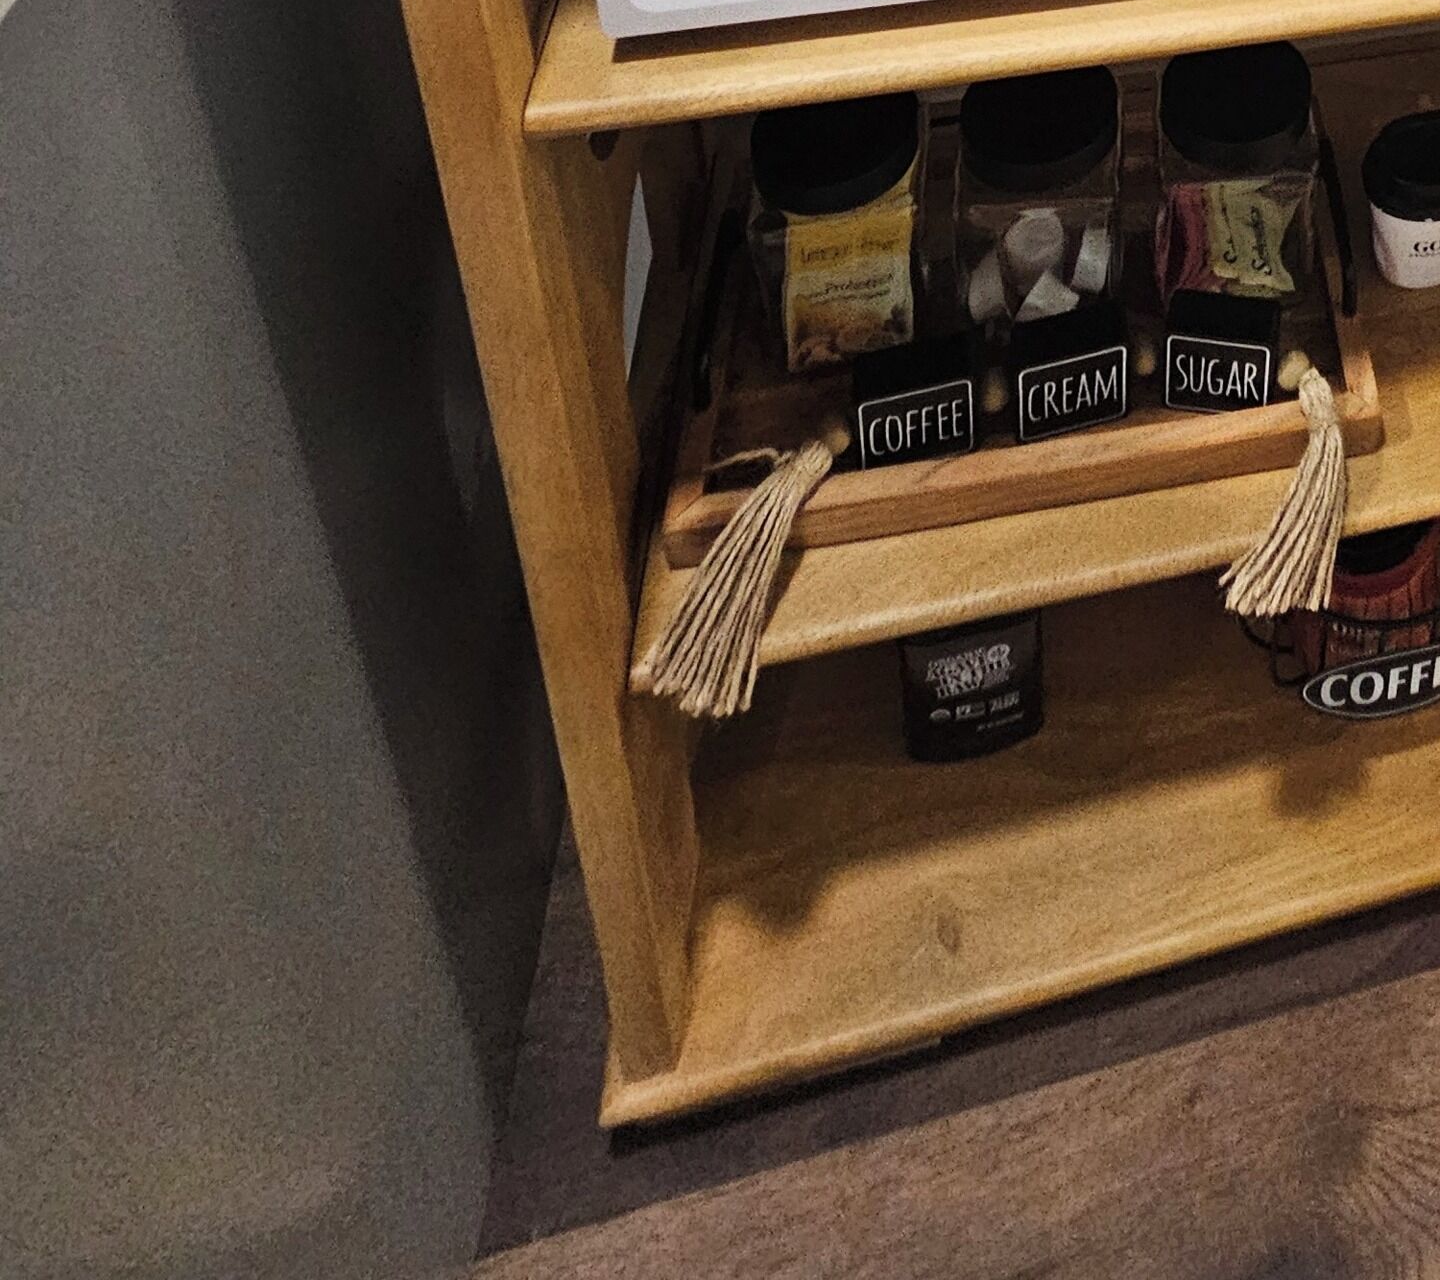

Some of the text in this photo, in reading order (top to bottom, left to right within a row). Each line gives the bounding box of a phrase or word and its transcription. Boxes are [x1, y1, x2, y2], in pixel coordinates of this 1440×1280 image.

[1027, 366, 1119, 424] CREAM
[1175, 353, 1260, 401] SUGAR
[869, 399, 965, 456] COFFEE
